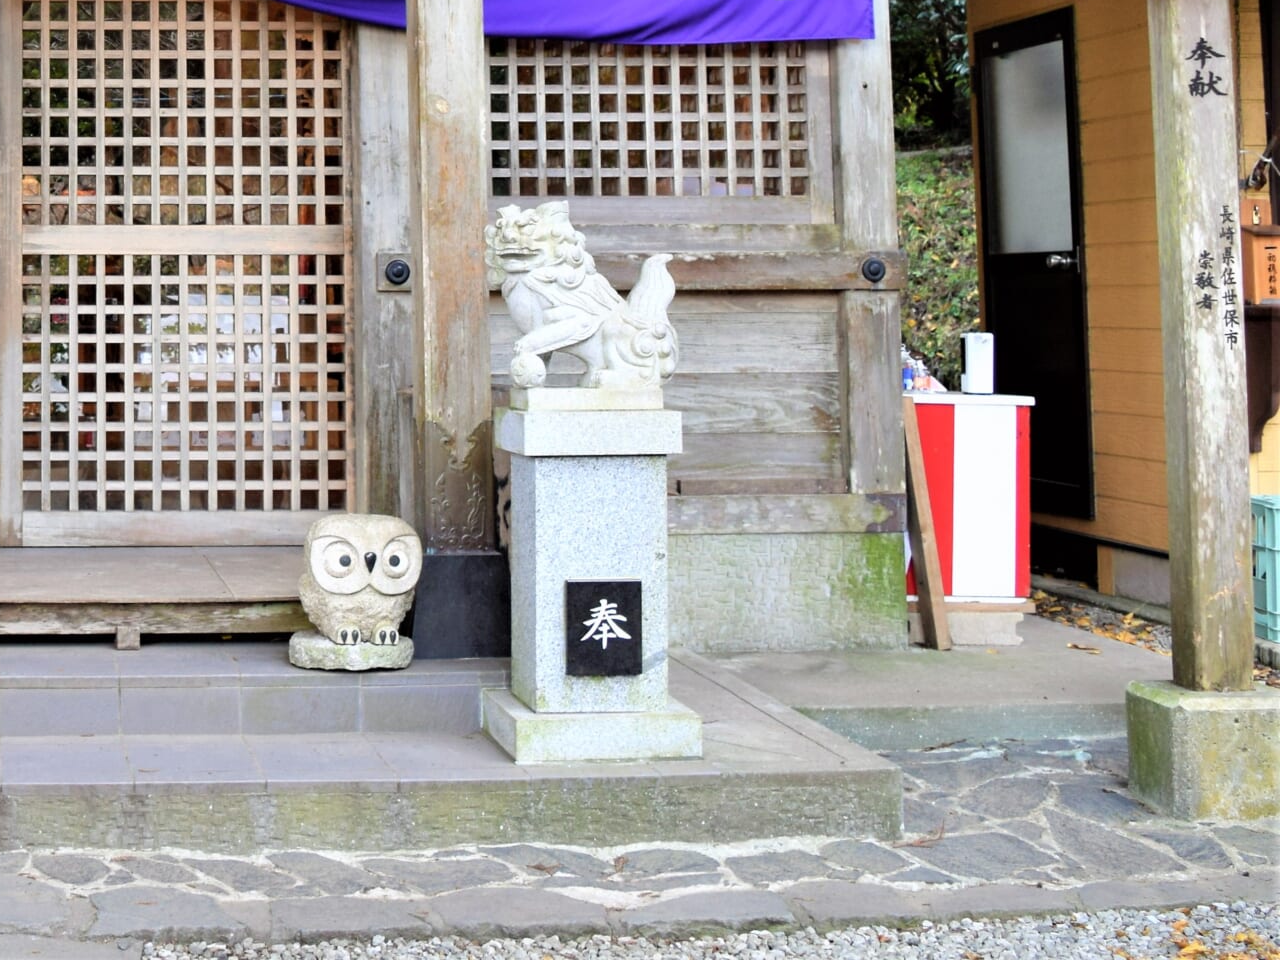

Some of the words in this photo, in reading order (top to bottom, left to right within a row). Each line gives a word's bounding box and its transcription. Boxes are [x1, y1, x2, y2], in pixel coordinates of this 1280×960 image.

[1185, 37, 1228, 98] 奉献
[1194, 249, 1219, 310] 崇敬者
[1219, 204, 1240, 351] 長崎県佐世保市
[580, 598, 632, 650] 奉
